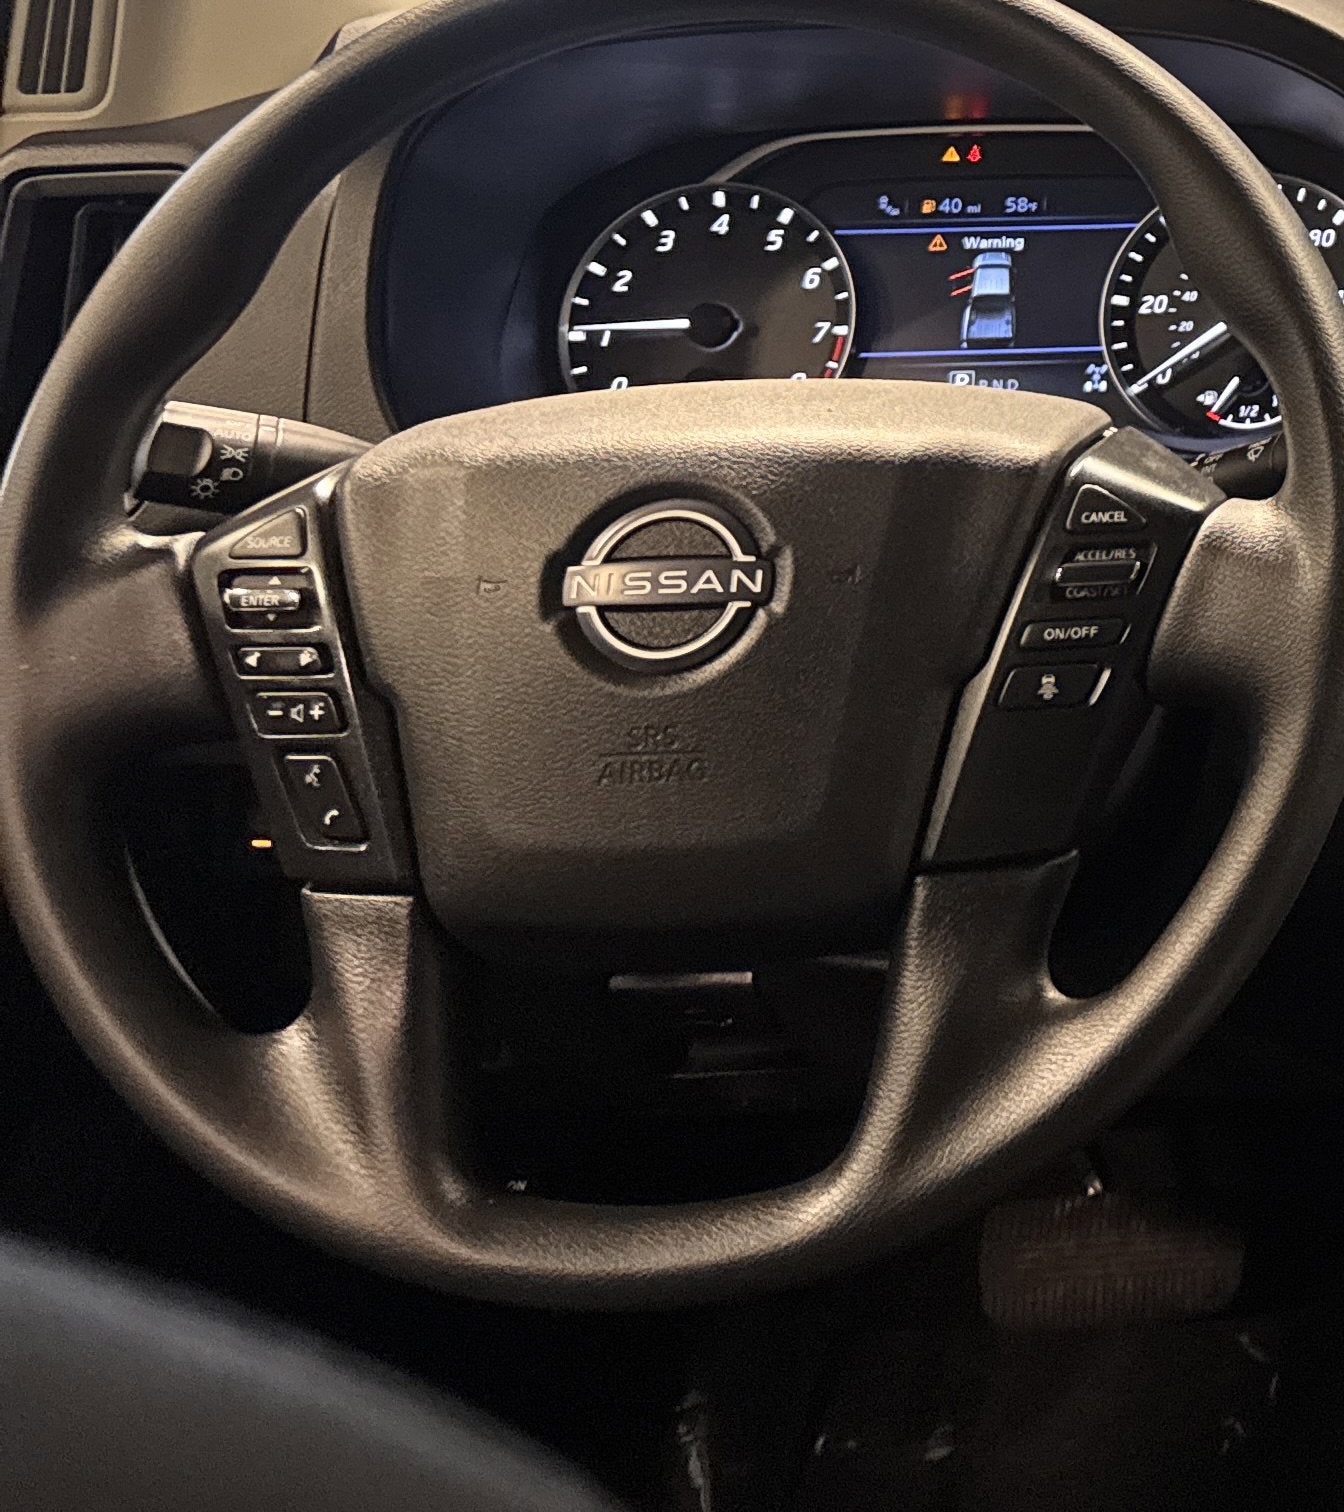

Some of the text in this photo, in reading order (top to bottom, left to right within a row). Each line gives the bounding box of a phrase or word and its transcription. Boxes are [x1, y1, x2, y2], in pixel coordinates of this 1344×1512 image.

[938, 197, 963, 213] 40
[709, 213, 730, 236] 4
[655, 230, 676, 252] 3
[763, 228, 785, 252] 5
[961, 236, 1025, 252] Warning
[611, 270, 633, 293] 2
[801, 267, 822, 290] 6
[1181, 290, 1198, 302] 40
[1138, 294, 1169, 315] 20
[811, 320, 832, 343] 7
[1177, 320, 1194, 332] 20
[1238, 405, 1260, 418] 1/2
[1081, 511, 1127, 524] CANCEL
[247, 535, 292, 549] SOURCE
[570, 569, 763, 599] NISSAN
[240, 594, 280, 607] ENTER
[1043, 626, 1098, 640] ON/OFF
